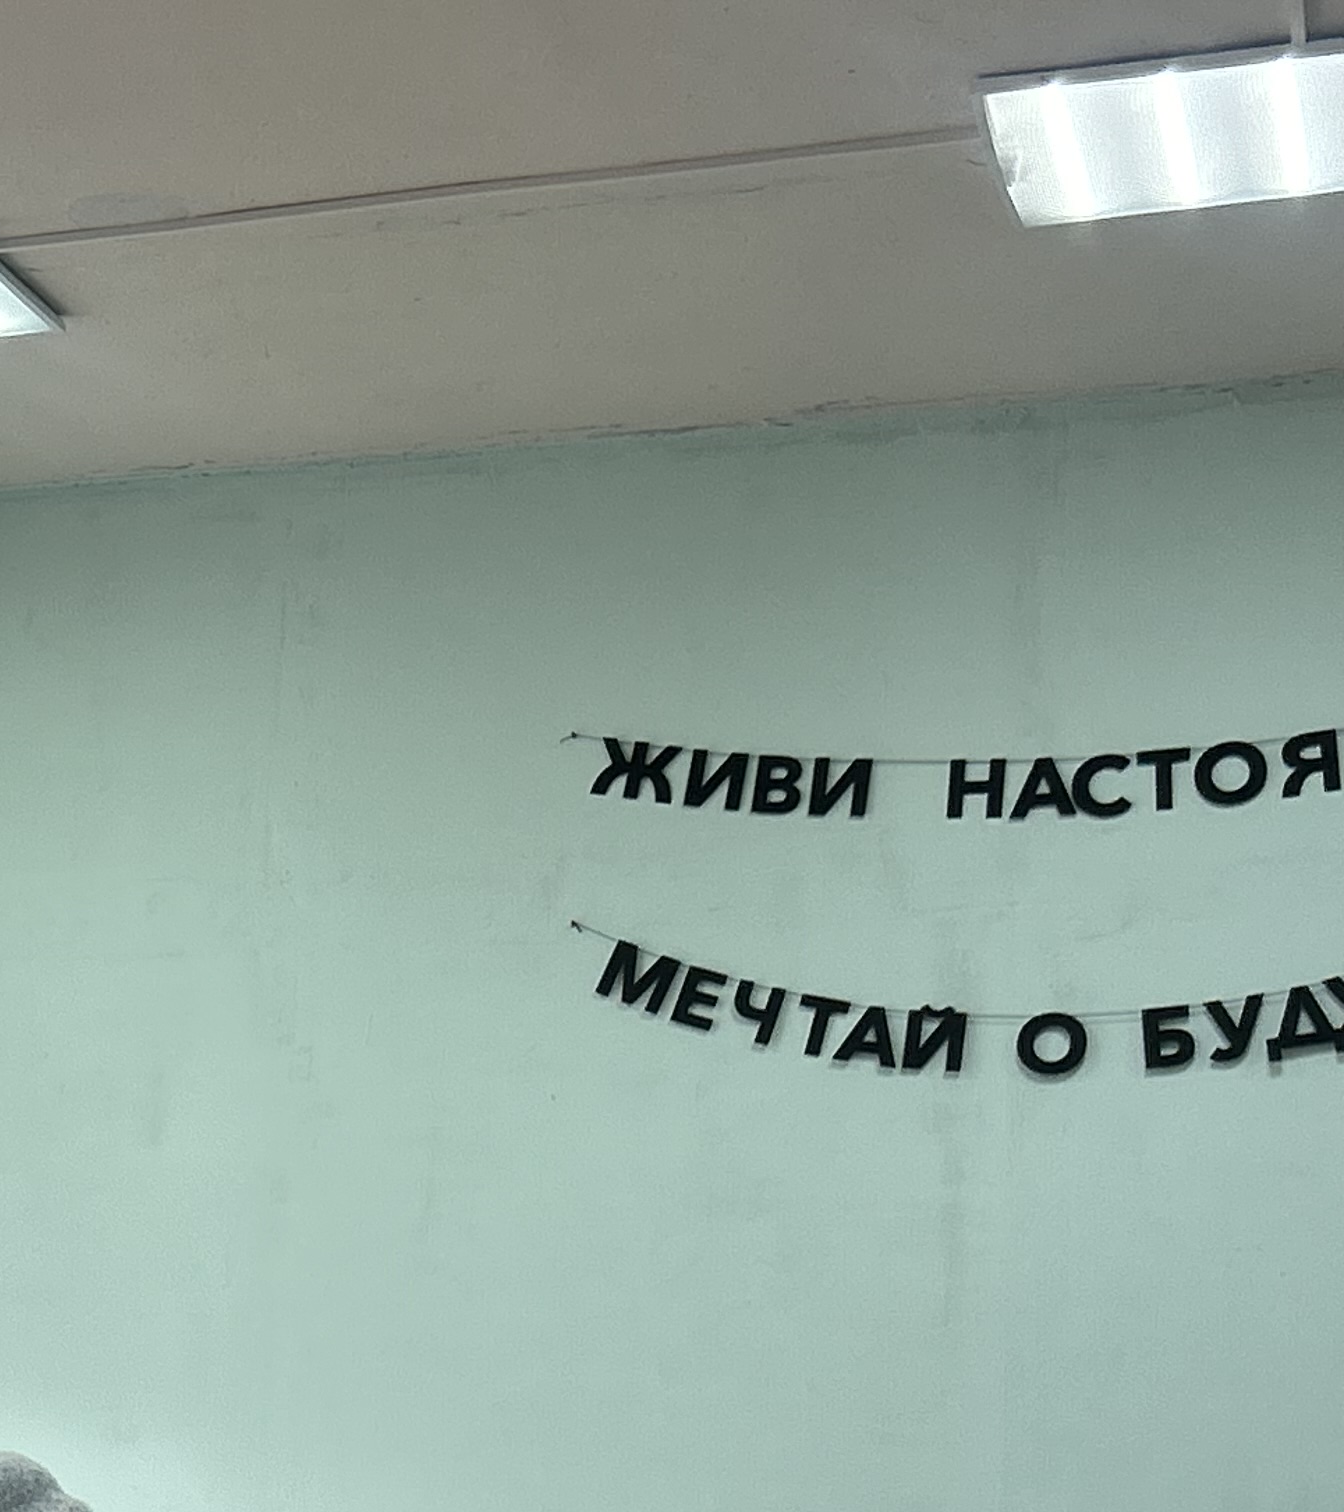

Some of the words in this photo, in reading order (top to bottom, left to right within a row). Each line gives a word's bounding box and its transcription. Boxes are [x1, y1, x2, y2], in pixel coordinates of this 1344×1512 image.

[590, 737, 873, 817] ЖИВИ
[946, 728, 1341, 819] НАСТОЯ
[595, 941, 968, 1074] МЕЧТАЙ
[1017, 1013, 1088, 1075] О
